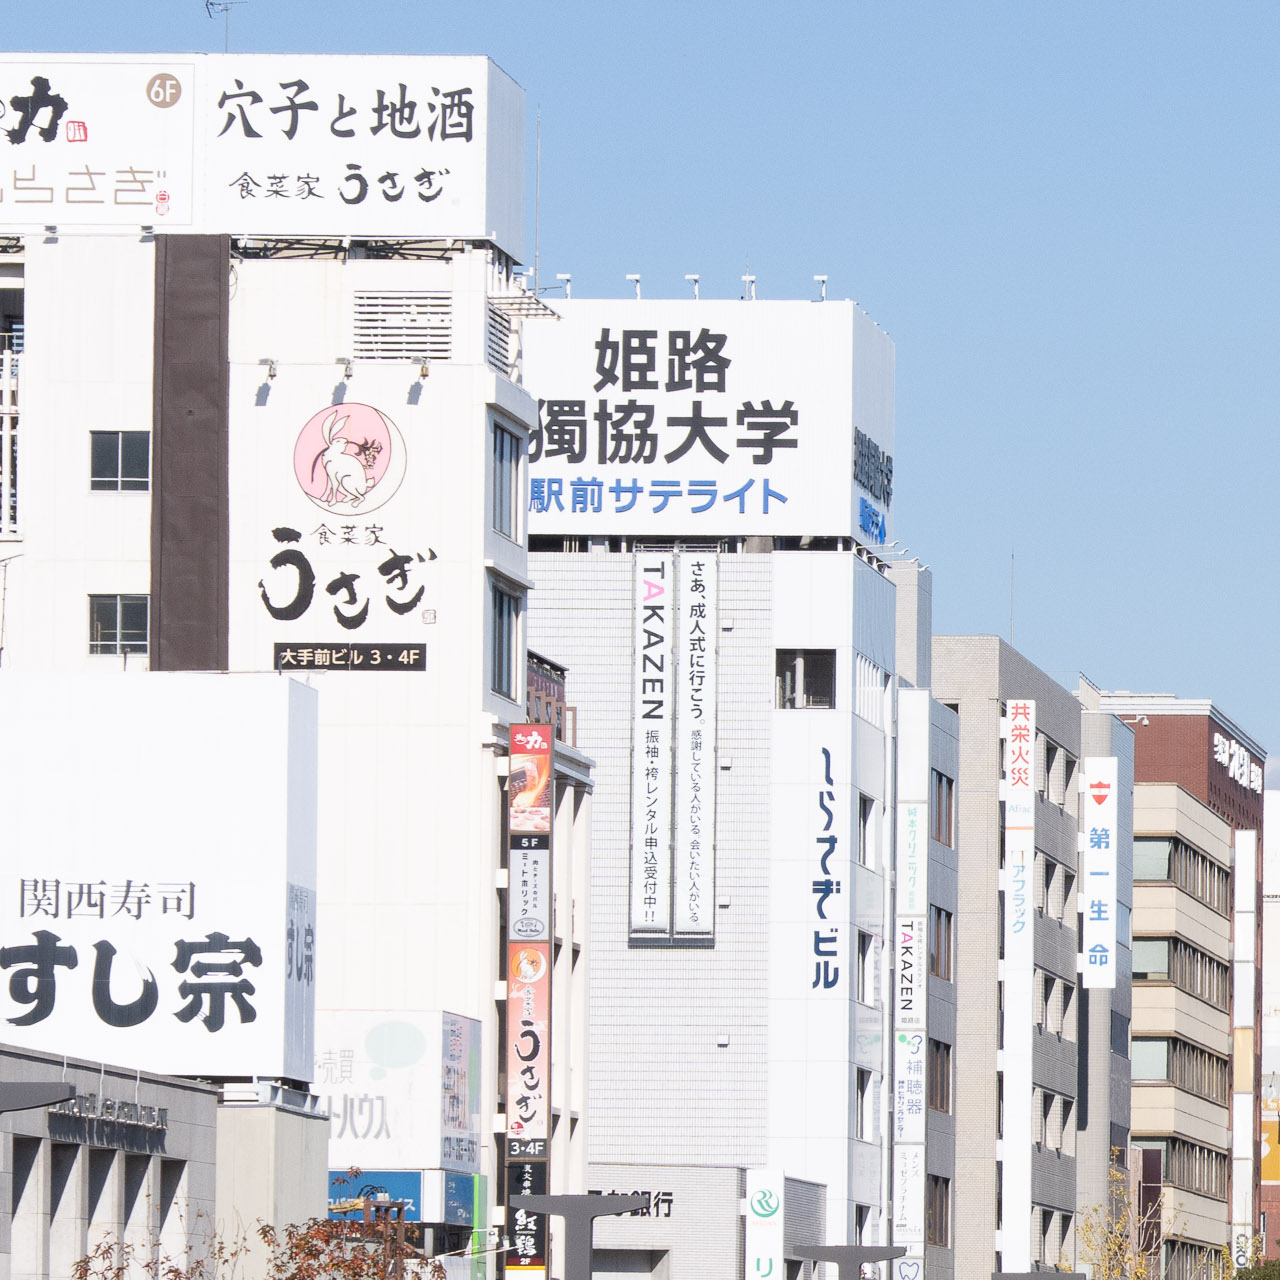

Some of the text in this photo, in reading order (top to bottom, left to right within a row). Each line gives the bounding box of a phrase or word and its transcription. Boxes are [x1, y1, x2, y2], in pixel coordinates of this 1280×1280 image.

[150, 79, 177, 103] 6F
[217, 79, 474, 143] 穴子と地酒
[229, 164, 451, 205] 食菜家 うさぎ
[593, 327, 732, 393] 姫路
[527, 399, 799, 465] 獨協大学
[528, 477, 788, 514] 駅前サテライト
[309, 523, 388, 546] 食菜家
[258, 527, 437, 630] うさぎ
[280, 647, 363, 665] 大手前ビル
[642, 561, 666, 720] TAKAZEN
[690, 561, 707, 725] さあ、成人式に行こう。
[1010, 702, 1032, 787] 共栄火災
[521, 838, 539, 848] 5F
[19, 879, 197, 921] 関西寿司
[1012, 863, 1027, 934] アフラック
[1089, 827, 1111, 967] 第一生命
[0, 930, 263, 1033] すし宗
[901, 921, 914, 1011] TAKAZEN
[516, 1019, 542, 1124] うさぎ
[906, 1059, 924, 1115] 補聴器
[520, 1257, 531, 1265] 2F
